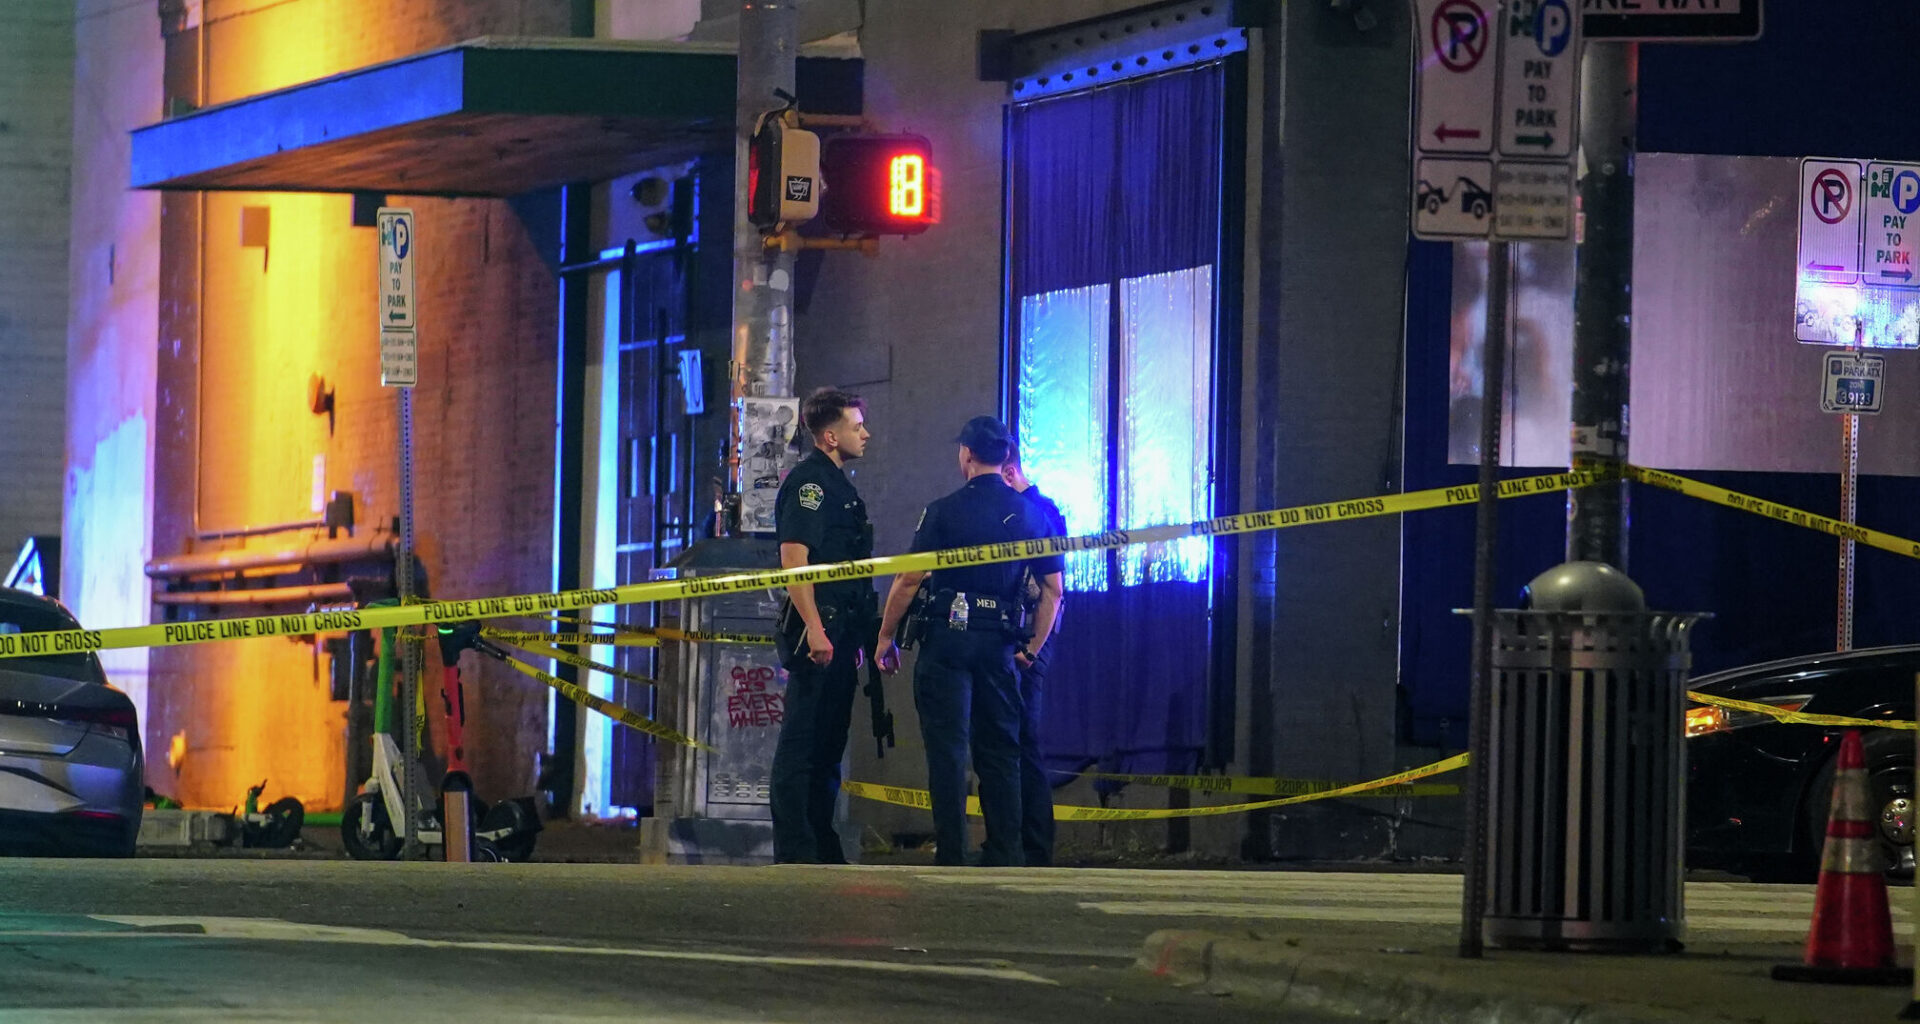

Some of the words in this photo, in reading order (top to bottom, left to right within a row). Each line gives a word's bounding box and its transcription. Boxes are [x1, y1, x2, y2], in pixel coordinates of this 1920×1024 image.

[1523, 60, 1553, 79] PAY
[1528, 85, 1546, 104] TO
[1515, 109, 1557, 128] PARK
[1883, 215, 1907, 229] PAY
[1886, 232, 1902, 247] TO
[1876, 249, 1910, 265] PARK
[389, 262, 403, 275] PAY
[392, 278, 401, 291] TO
[387, 294, 406, 308] PARK
[1843, 366, 1865, 377] PARK
[1867, 367, 1880, 378] ATX
[1445, 486, 1479, 503] POLI
[1498, 480, 1531, 497] LINE
[1535, 476, 1555, 491] DO
[1559, 472, 1590, 488] NOT
[1192, 516, 1240, 535] POLICE
[1244, 513, 1276, 530] LINE
[1279, 510, 1300, 525] DO
[1305, 505, 1332, 522] NOT
[1336, 499, 1385, 517] CROSS
[1833, 522, 1868, 542] CROSS
[935, 545, 985, 566] POLICE
[989, 542, 1021, 560] LINE
[1025, 540, 1045, 556] DO
[1048, 536, 1077, 553] NOT
[1082, 531, 1130, 549] CROSS
[680, 577, 730, 595] POLICE
[734, 574, 766, 589] LINE
[770, 570, 789, 585] DO
[794, 567, 822, 582] NOT
[827, 562, 875, 578] CROSS
[424, 602, 473, 620] POLICE
[478, 599, 509, 615] LINE
[514, 596, 533, 611] DO
[538, 592, 567, 609] NOT
[571, 588, 619, 606] CROSS
[976, 598, 997, 609] MED
[165, 622, 216, 643] POLICE
[220, 618, 251, 639] LINE
[256, 617, 276, 636] DO
[281, 614, 308, 634] NOT
[314, 610, 362, 631] CROSS
[21, 634, 49, 653] NOT
[54, 630, 102, 651] CROSS
[731, 665, 775, 681] GOD
[736, 680, 766, 694] IS
